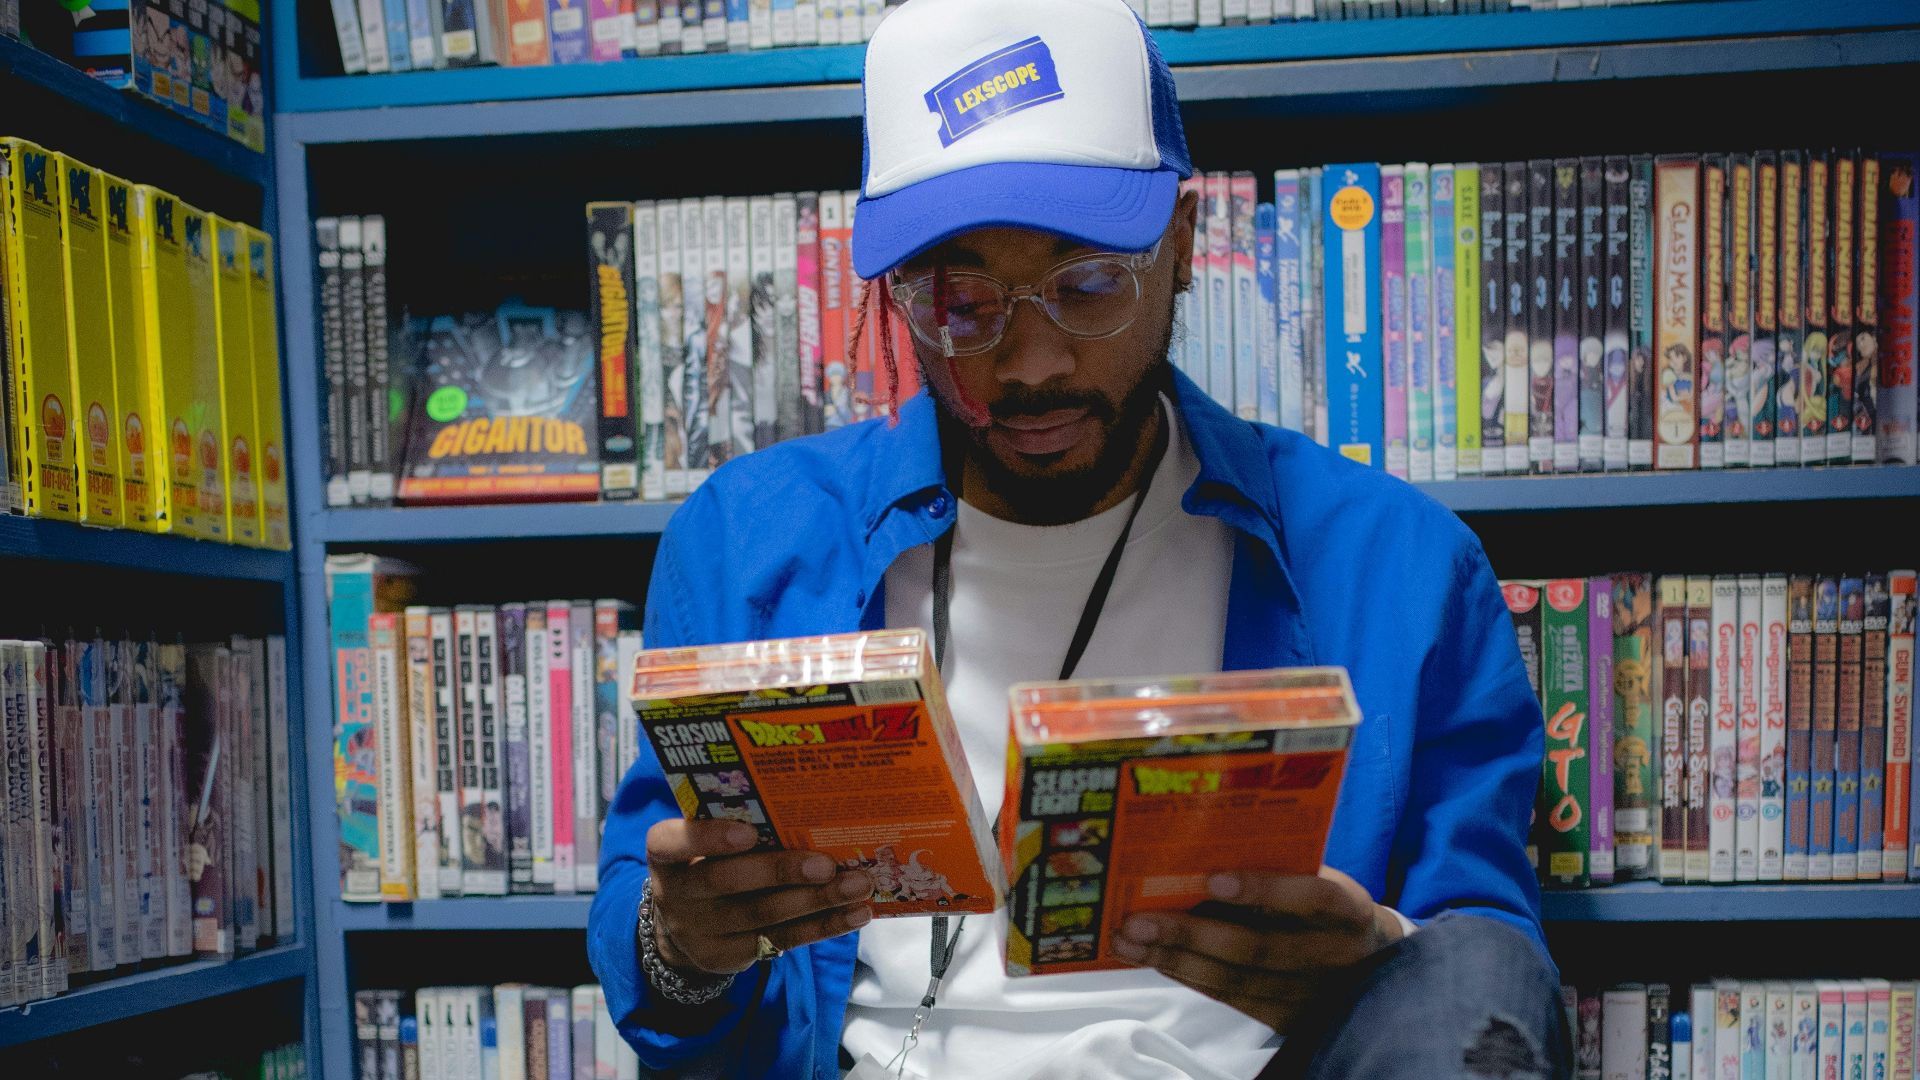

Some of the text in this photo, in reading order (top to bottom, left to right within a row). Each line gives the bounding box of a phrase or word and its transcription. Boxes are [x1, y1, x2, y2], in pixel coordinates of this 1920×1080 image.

[954, 63, 1041, 114] LEXSCOPE
[1670, 202, 1691, 328] GLASS MASK
[597, 265, 629, 360] GIGANTOR
[428, 416, 587, 458] GIGANTOR
[1895, 649, 1909, 682] GUN
[654, 721, 731, 747] SEASON
[739, 720, 825, 746] DRAGON
[872, 707, 919, 741] Z
[1718, 719, 1734, 730] 2
[1742, 718, 1758, 730] 2
[1768, 718, 1784, 730] 2
[1893, 695, 1908, 758] SWORD
[664, 745, 708, 767] NINE
[1547, 702, 1585, 832] GTO
[1032, 767, 1118, 793] SEASON
